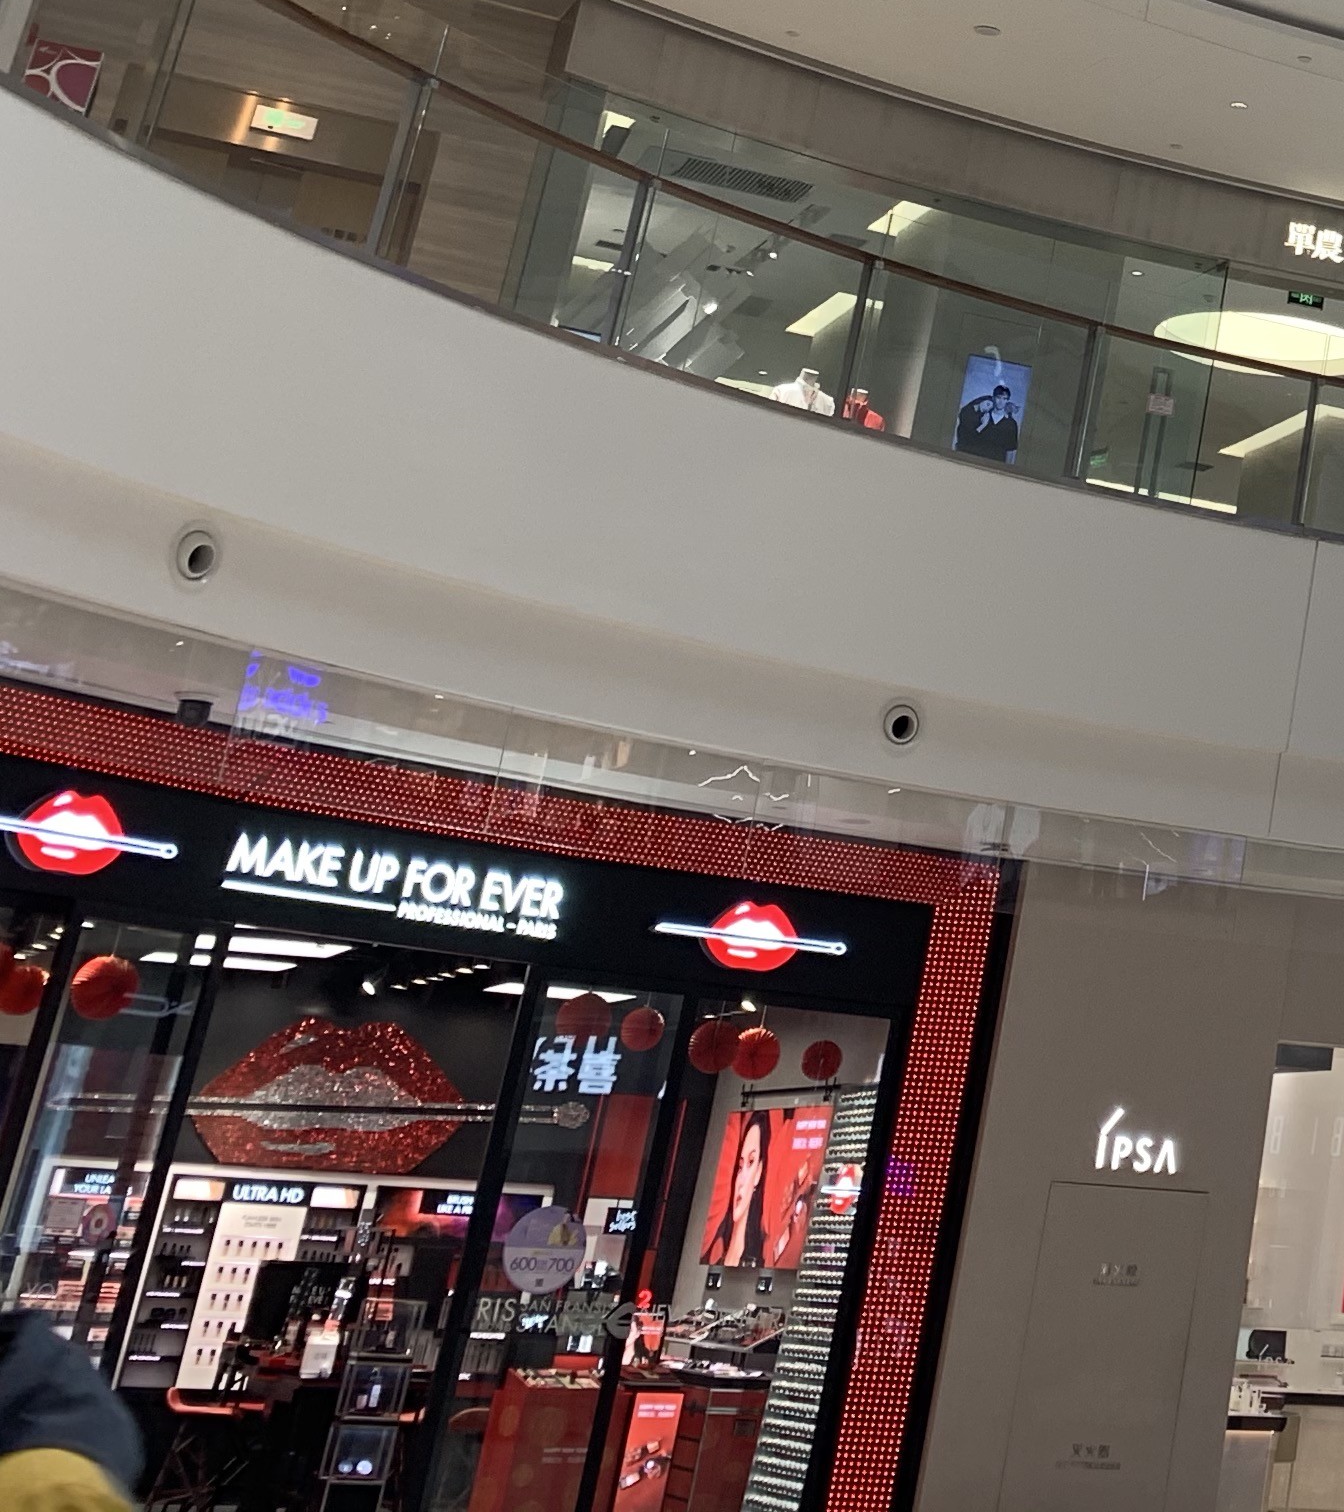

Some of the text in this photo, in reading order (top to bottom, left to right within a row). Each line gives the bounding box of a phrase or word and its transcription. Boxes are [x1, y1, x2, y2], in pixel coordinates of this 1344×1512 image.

[225, 832, 565, 920] MAKE UP FOR EVER
[396, 900, 505, 933] PROFESSIONAL
[516, 918, 558, 940] PARIS
[233, 1184, 305, 1203] ULTRA HD
[510, 1257, 575, 1272] 600 700
